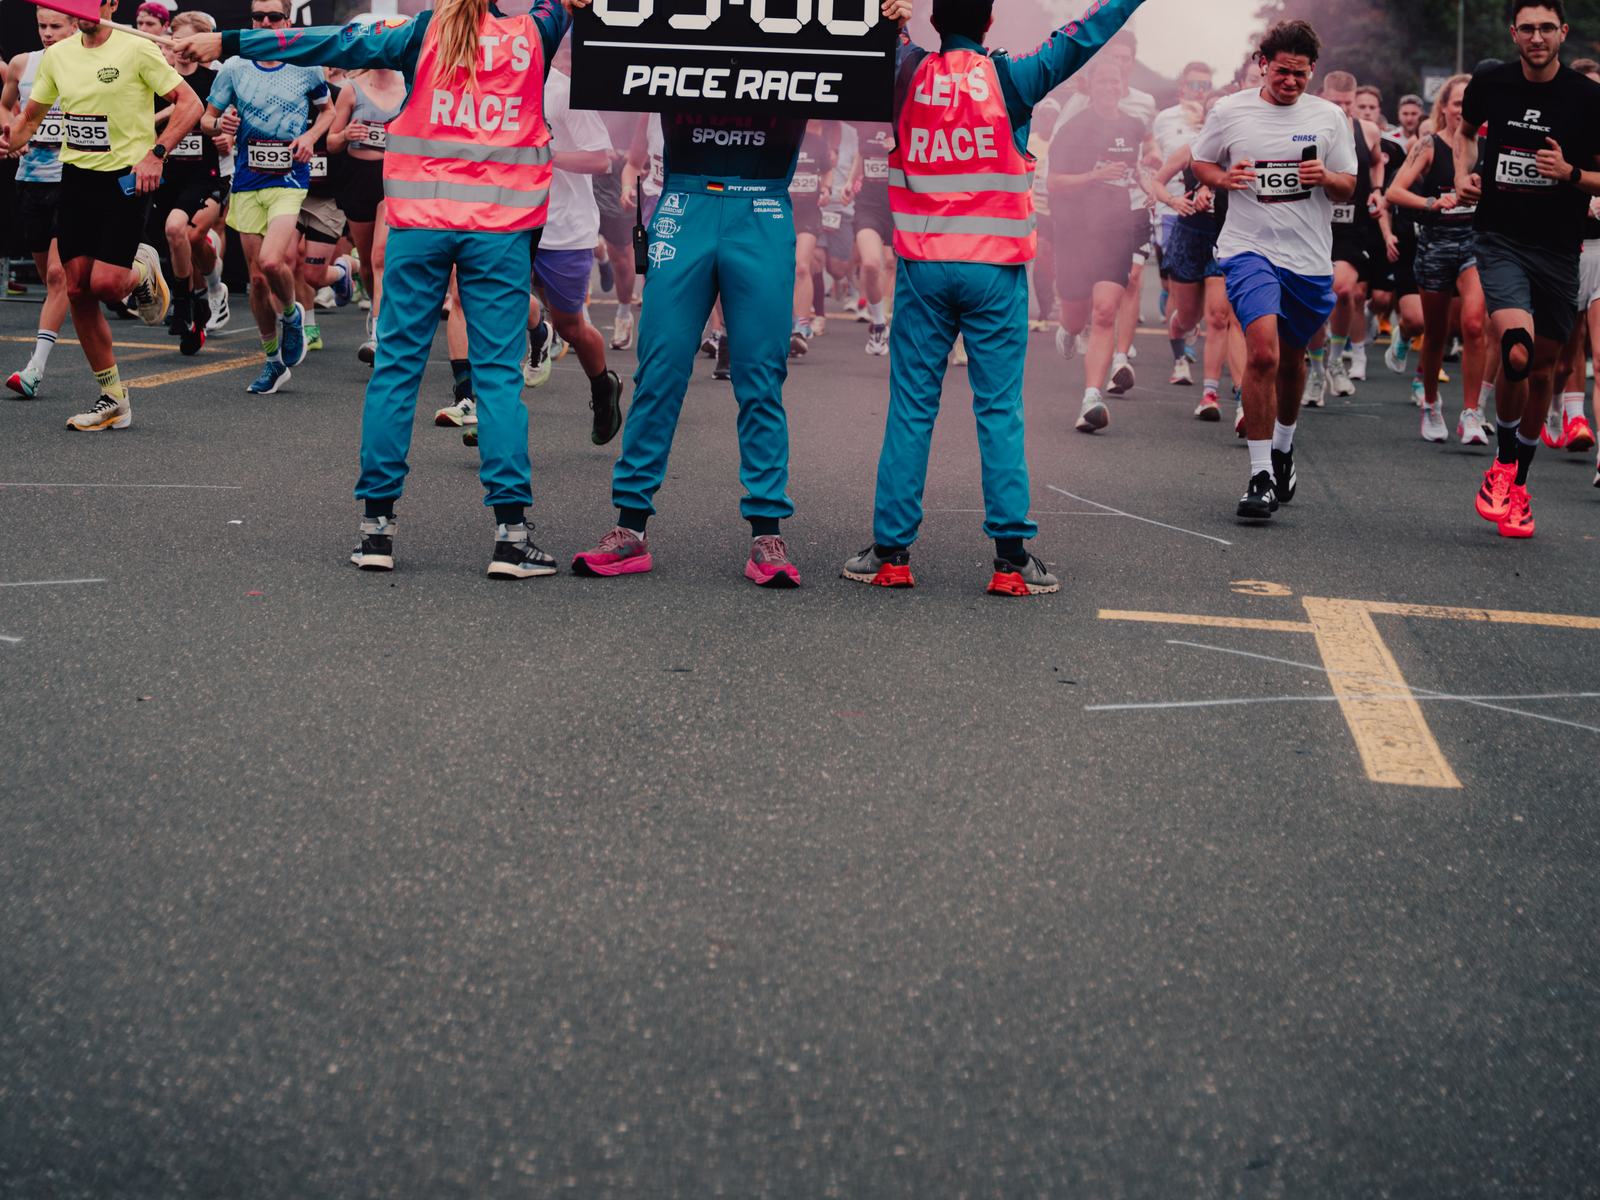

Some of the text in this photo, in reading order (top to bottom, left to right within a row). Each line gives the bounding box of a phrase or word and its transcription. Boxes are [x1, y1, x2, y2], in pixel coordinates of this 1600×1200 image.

[622, 65, 843, 102] PACE RACE
[430, 88, 523, 131] RACE
[65, 124, 107, 139] 1535
[692, 128, 766, 146] SPORTS
[908, 126, 998, 163] RACE
[250, 150, 291, 162] 1693
[1507, 177, 1547, 185] ALEXANDER
